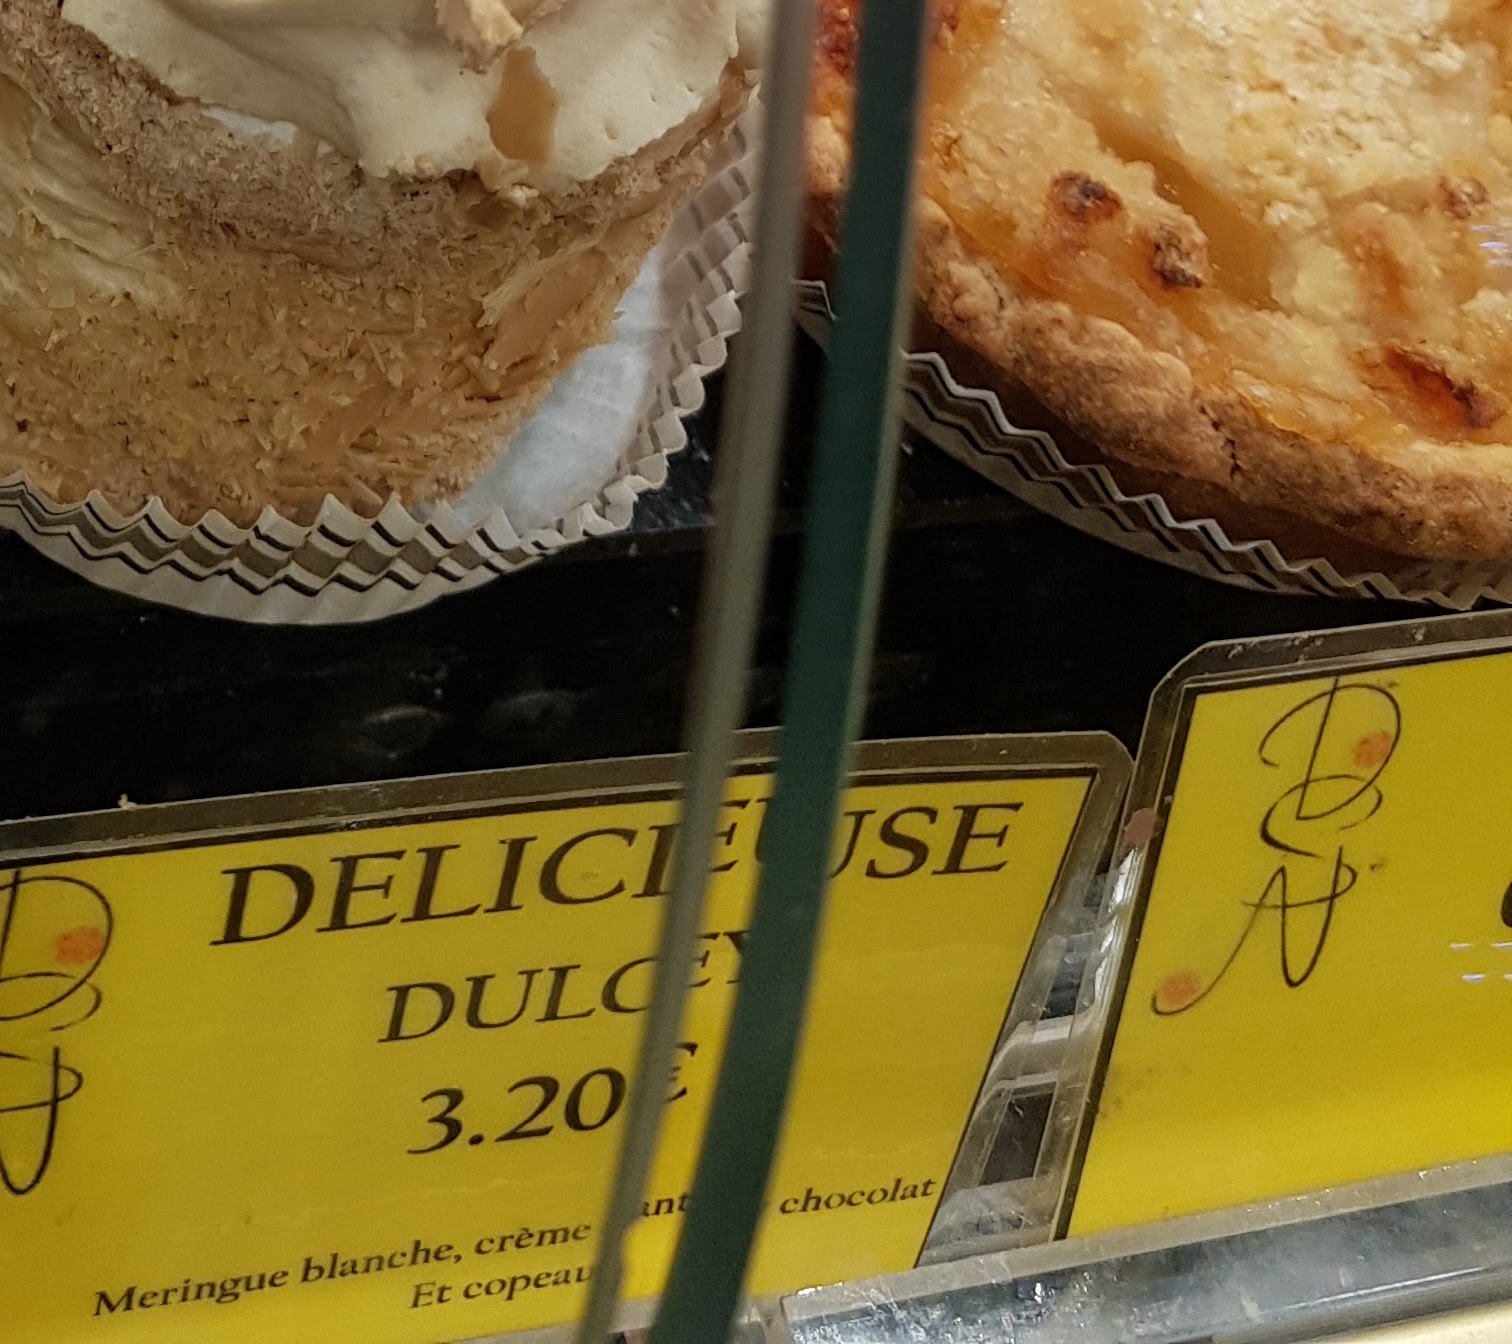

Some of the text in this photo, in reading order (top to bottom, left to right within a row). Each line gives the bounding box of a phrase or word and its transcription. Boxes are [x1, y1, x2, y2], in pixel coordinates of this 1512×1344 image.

[92, 1177, 938, 1317] Meringue blanche, crème chocolat
[408, 1265, 595, 1309] Et copeau
